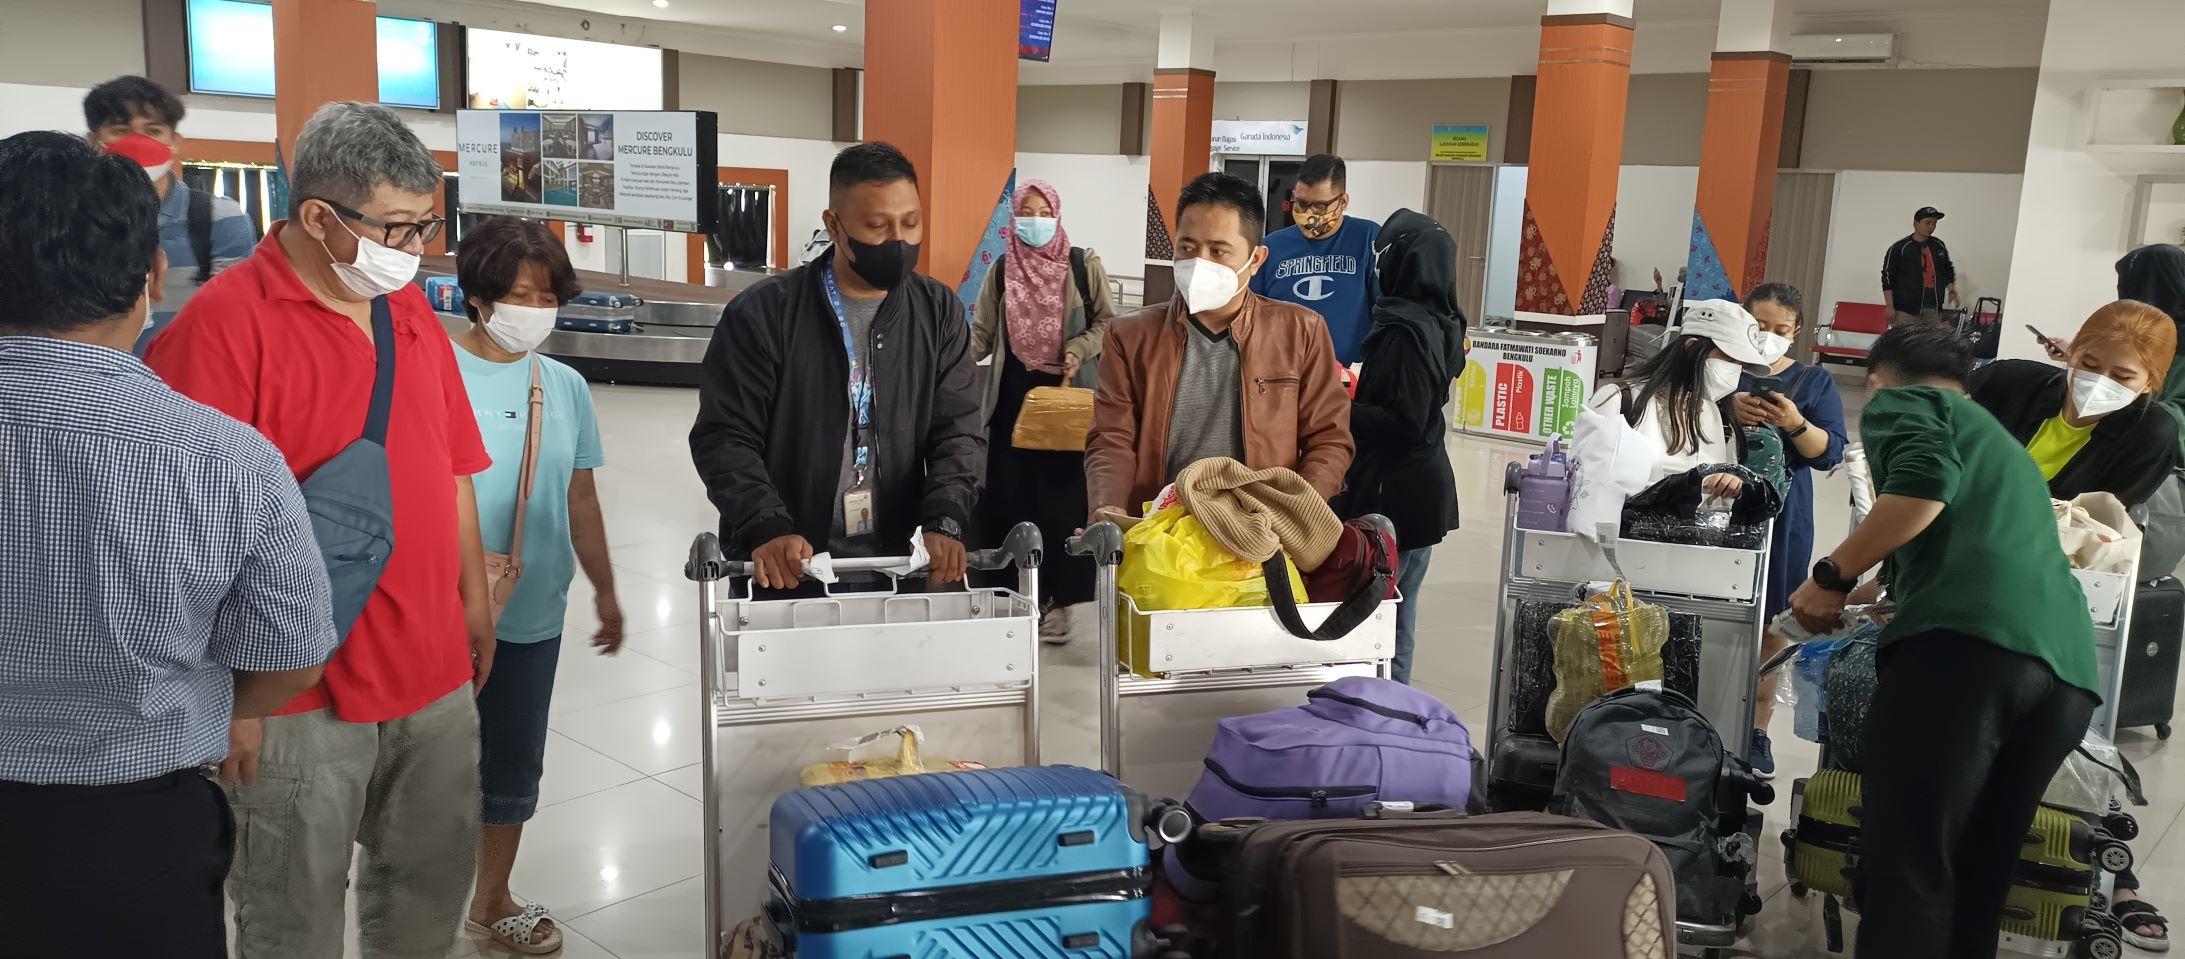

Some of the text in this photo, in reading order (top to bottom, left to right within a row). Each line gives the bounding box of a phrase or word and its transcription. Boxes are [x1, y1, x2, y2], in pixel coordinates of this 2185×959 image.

[636, 131, 673, 142] DISCOVER
[1240, 132, 1291, 141] Garuda Indonesia
[458, 142, 499, 154] MERCURE
[617, 144, 693, 157] MERCURE BENGKULU
[1275, 254, 1357, 279] SPRINGFIELD
[1472, 340, 1567, 357] BANDARA FATMAWATI SOEKARNO
[1502, 352, 1534, 363] BENGKULU
[1516, 370, 1524, 394] Plastik
[1561, 376, 1572, 408] Sampah
[1569, 378, 1580, 409] Lainnya
[1495, 382, 1508, 427] PLASTIC
[1542, 374, 1557, 434] OTHER WASTE
